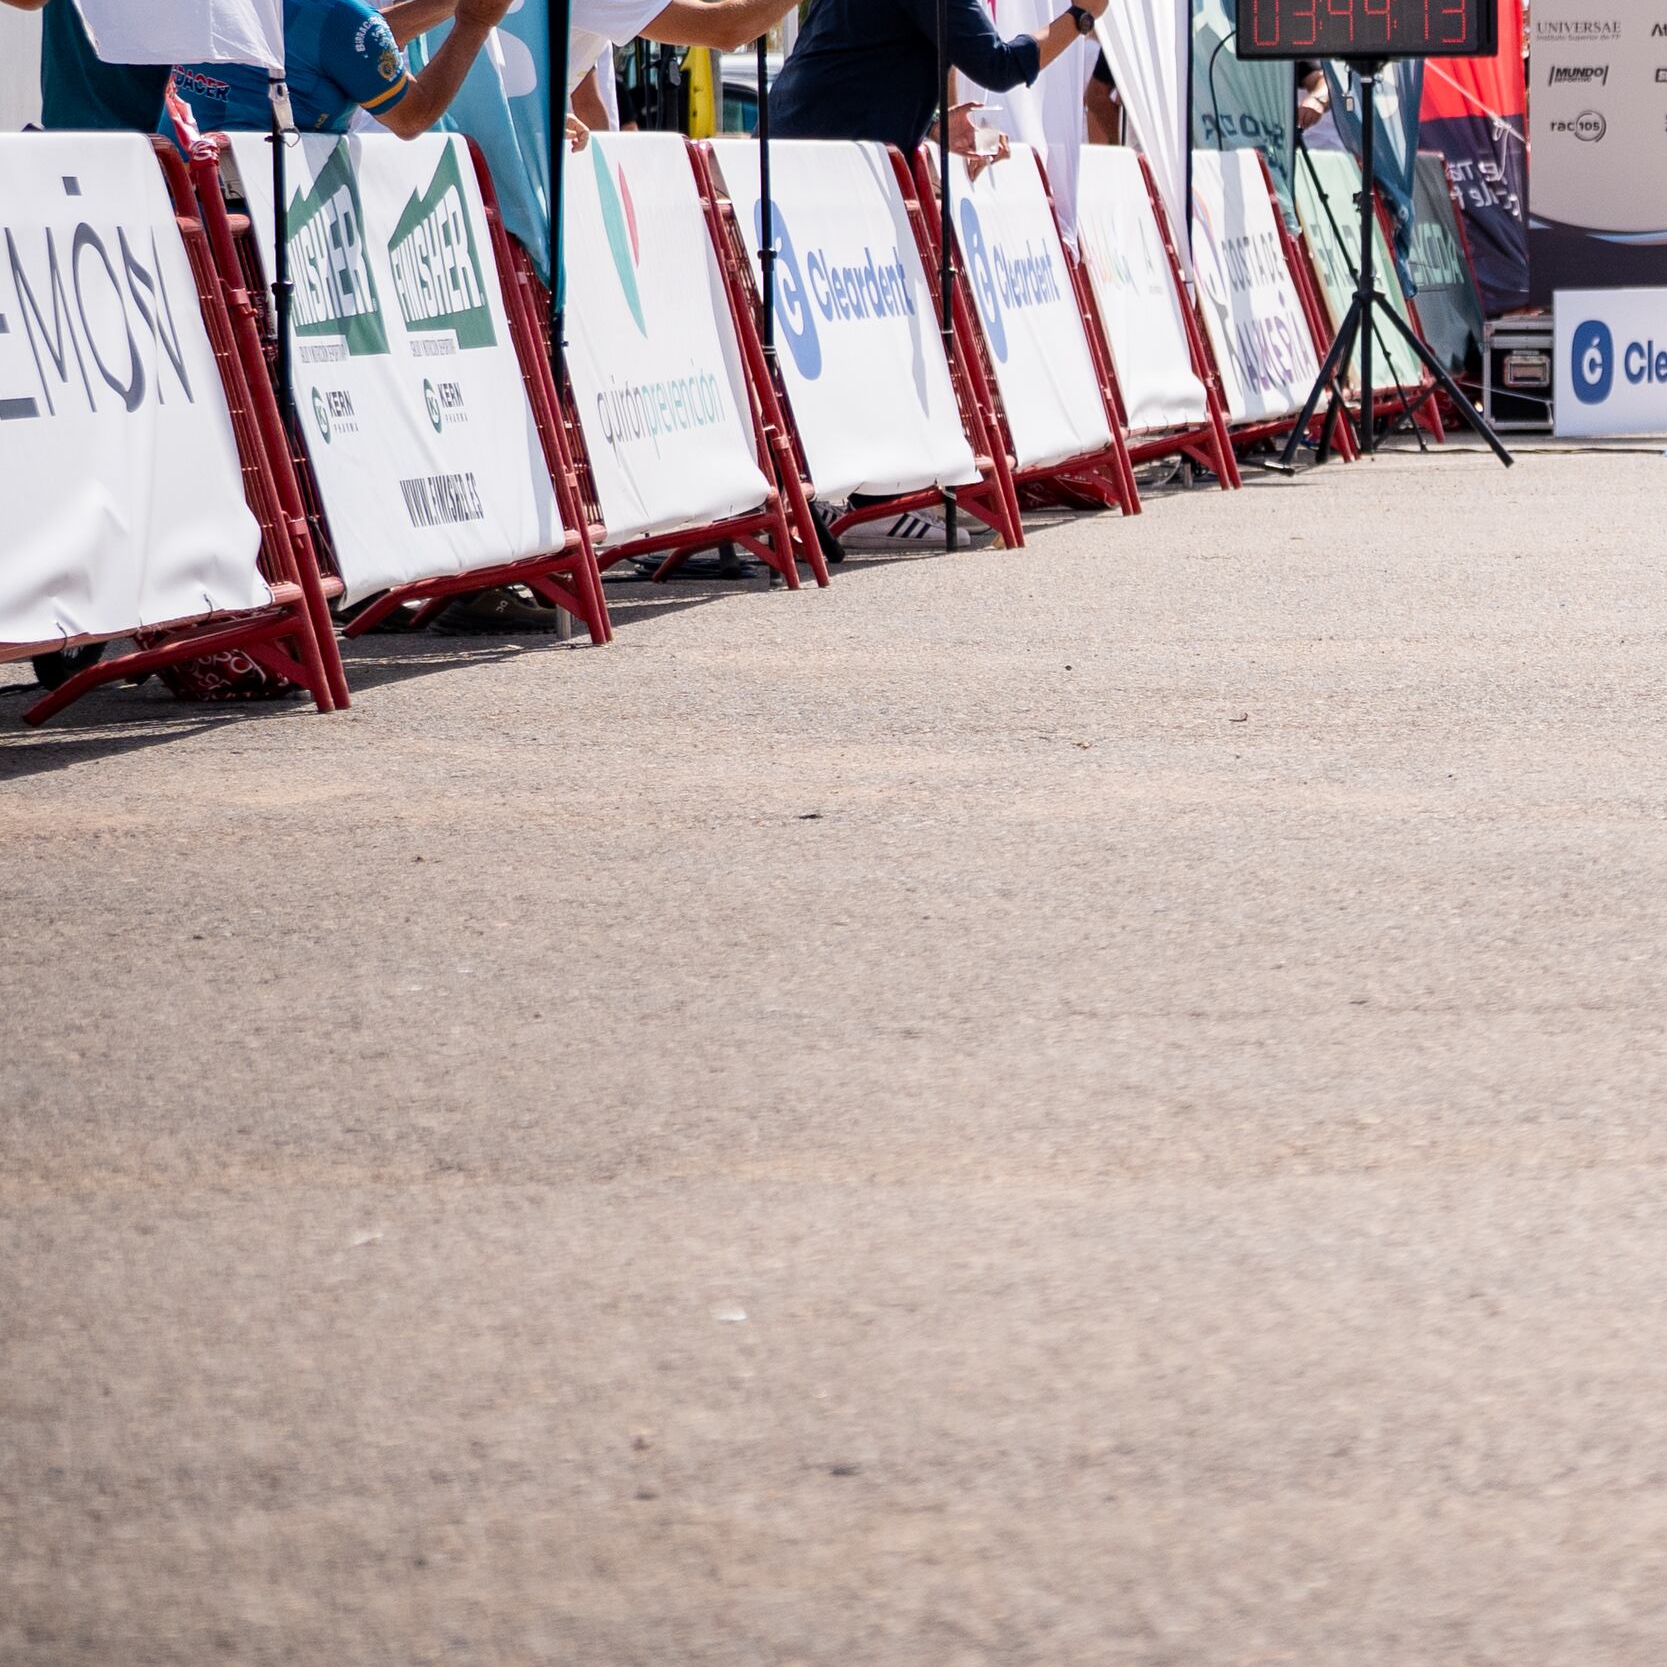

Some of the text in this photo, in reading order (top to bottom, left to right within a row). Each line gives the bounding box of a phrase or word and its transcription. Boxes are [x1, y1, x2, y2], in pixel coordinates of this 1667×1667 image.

[1536, 22, 1622, 34] UNIVERSAE
[1553, 66, 1604, 78] MUNDO
[1579, 120, 1601, 132] 105
[807, 246, 916, 323] Cleardent
[993, 237, 1061, 311] Cleardent
[326, 390, 355, 417] KERN
[437, 382, 465, 408] KERN
[597, 358, 725, 468] quirónprevención
